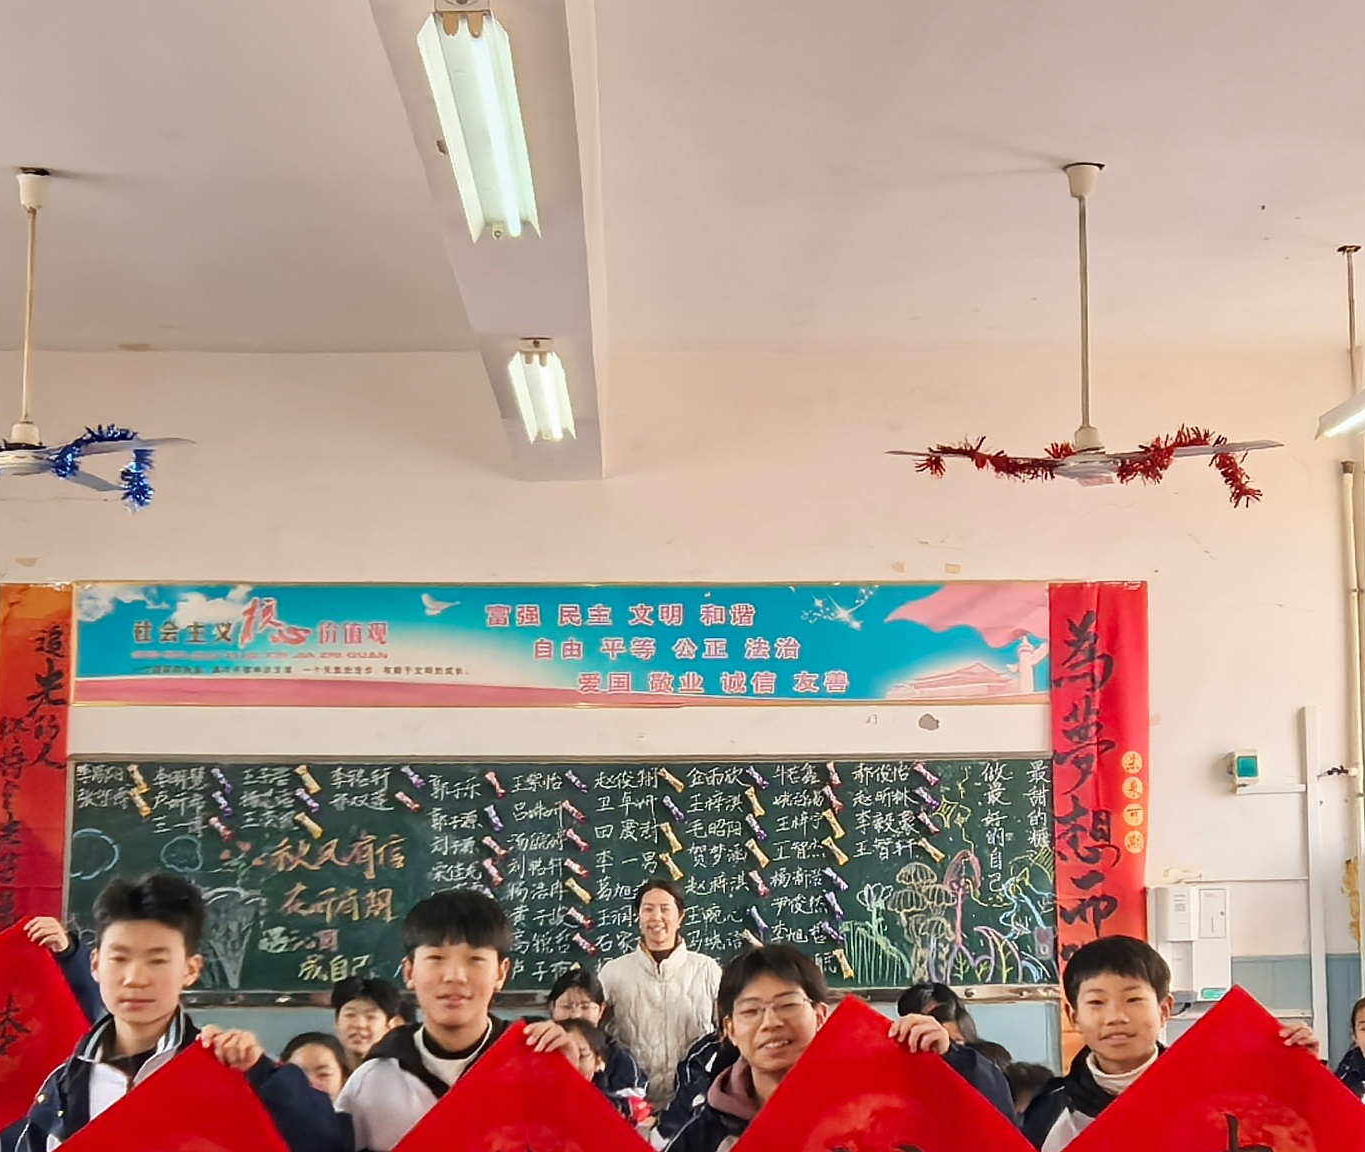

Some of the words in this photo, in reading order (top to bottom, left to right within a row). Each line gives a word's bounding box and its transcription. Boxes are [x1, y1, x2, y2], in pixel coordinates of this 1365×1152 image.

[486, 604, 540, 626] 富强
[558, 604, 612, 626] 民主
[629, 604, 683, 626] 文明
[700, 604, 755, 626] 和谐
[533, 638, 583, 660] 自由
[601, 638, 656, 660] 平等
[673, 638, 728, 660] 公正
[745, 638, 800, 660] 法治
[577, 672, 631, 694] 爱国
[649, 672, 704, 694] 敬业
[721, 672, 777, 694] 诚信
[793, 672, 849, 694] 友善
